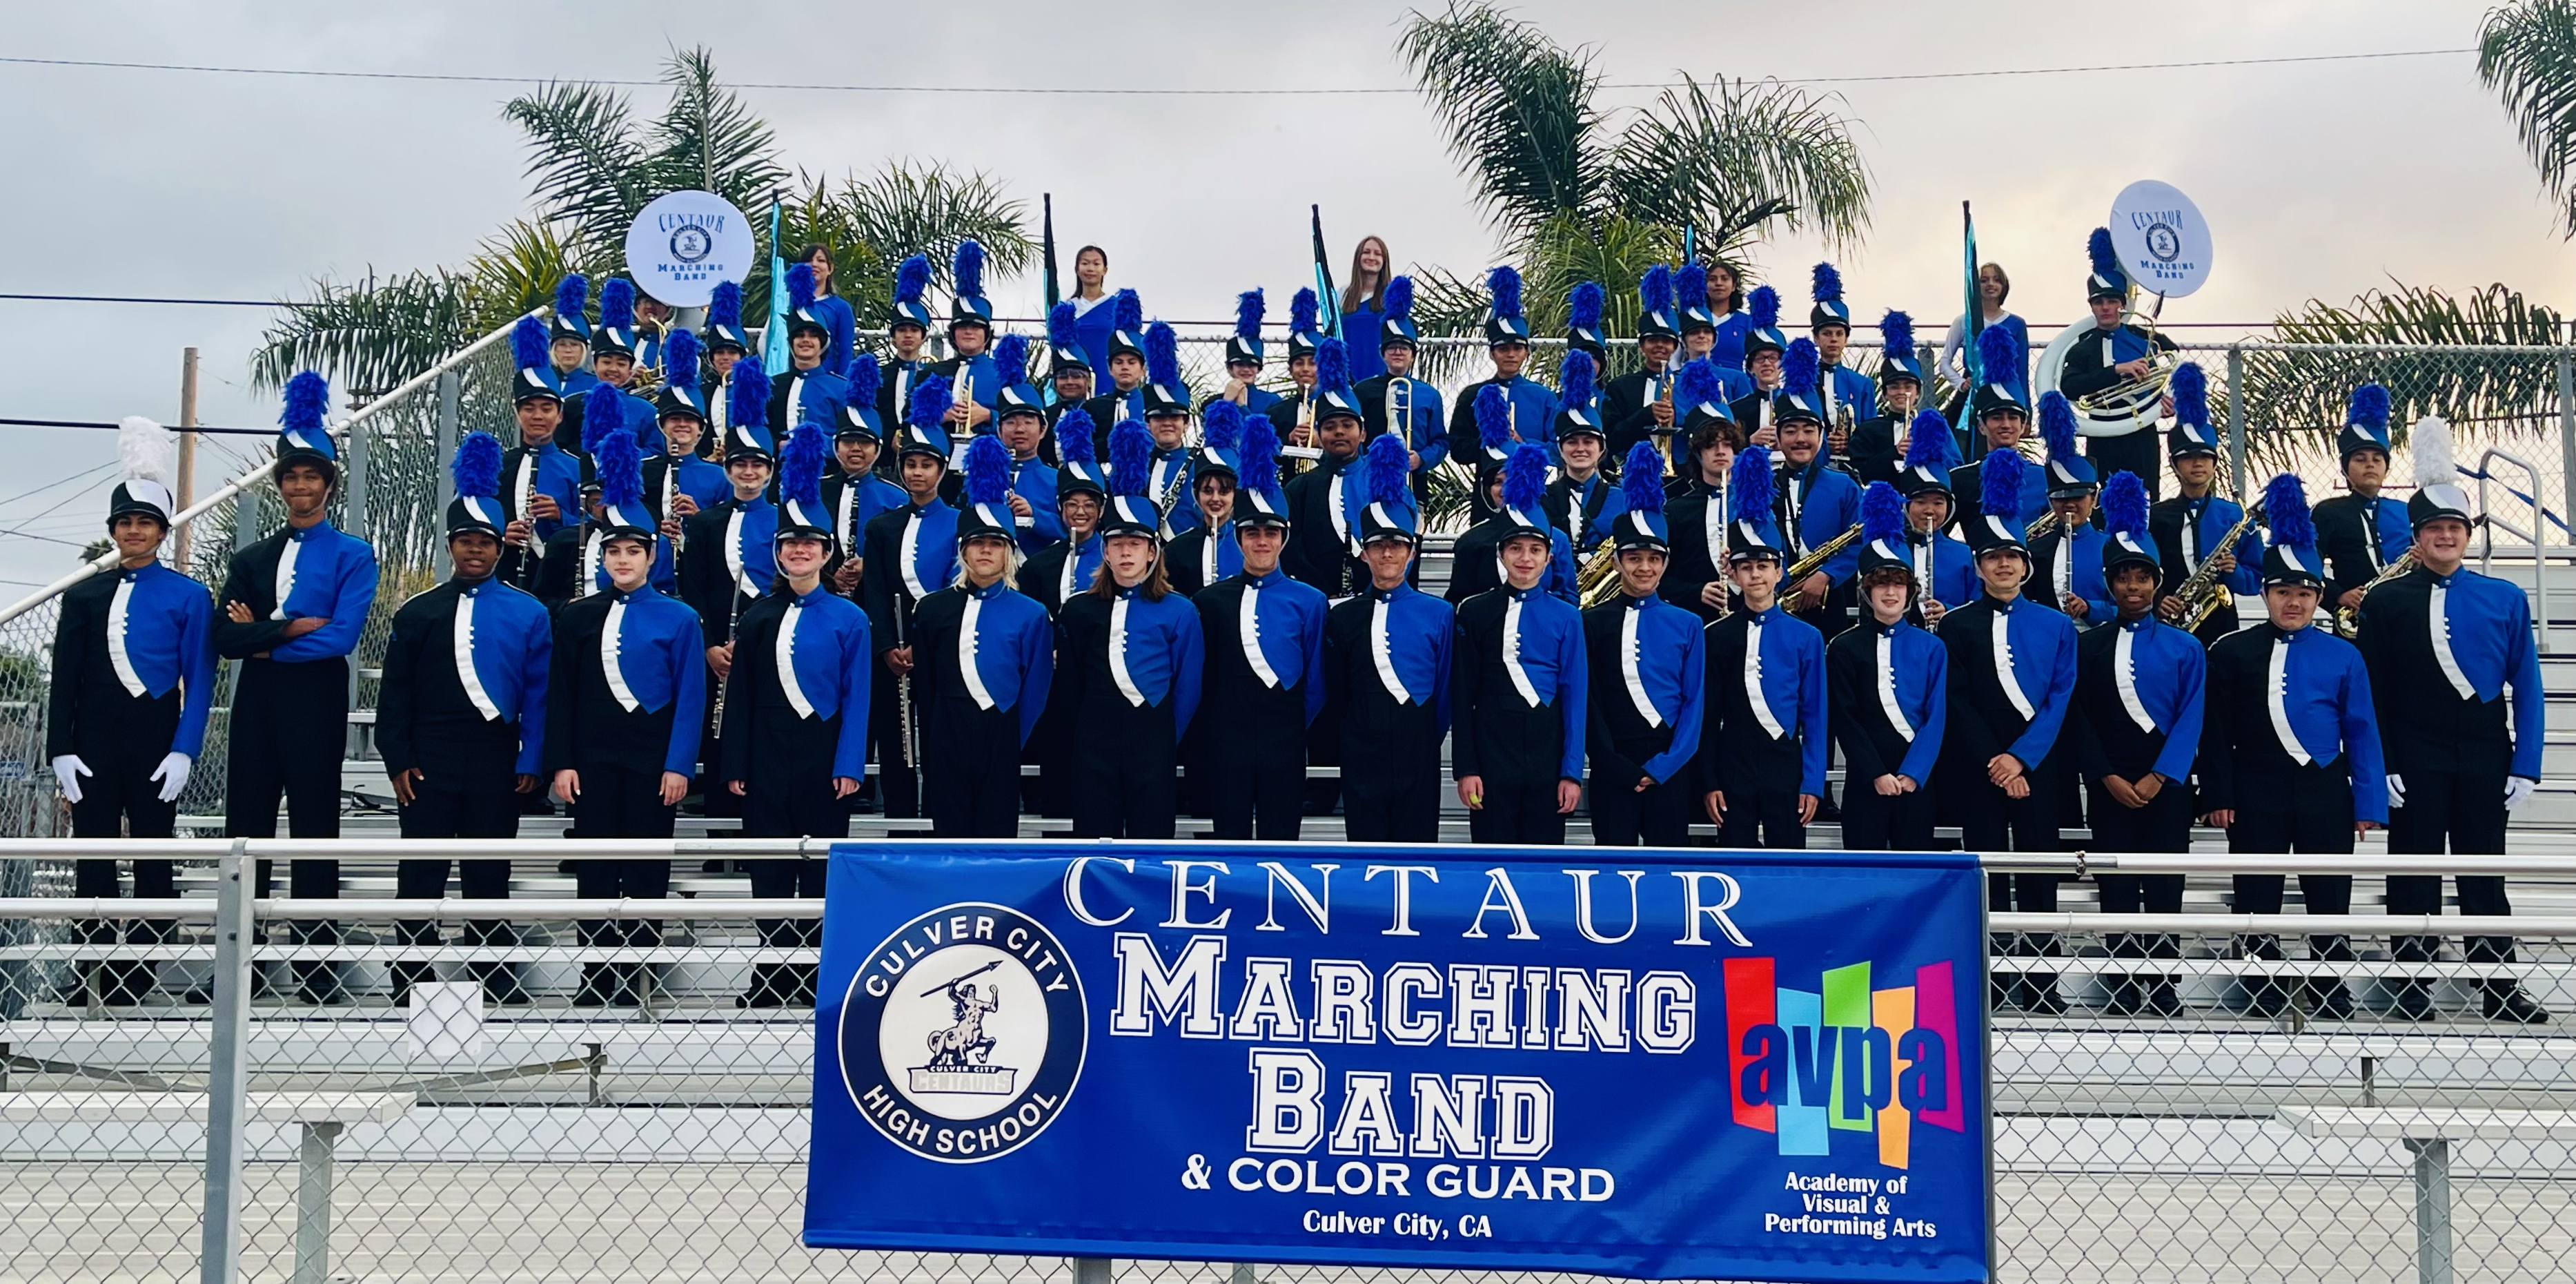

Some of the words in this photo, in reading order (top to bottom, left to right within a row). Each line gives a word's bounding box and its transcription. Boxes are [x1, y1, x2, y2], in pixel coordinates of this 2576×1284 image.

[658, 213, 725, 233] CENTAUR
[2132, 209, 2183, 231] CENTAUR
[658, 264, 724, 272] MARCHING
[2141, 260, 2195, 270] MARCHING
[2156, 270, 2184, 279] BAND
[1063, 857, 1753, 948] CENTAUR
[865, 915, 994, 998] CULVER
[1007, 927, 1069, 993] CITY
[1110, 932, 1696, 1054] MARCHING
[912, 1072, 1012, 1092] CENTAURS
[1740, 1023, 1947, 1120] avpa
[1246, 1047, 1554, 1160] BAND
[863, 1084, 931, 1146] HIGH
[935, 1092, 1057, 1154] SCHOOL
[1181, 1154, 1212, 1190] &
[1228, 1157, 1410, 1196] COLOR
[1426, 1164, 1615, 1202] GUARD
[1784, 1171, 1880, 1197] Academy
[1886, 1175, 1909, 1195] of
[1802, 1193, 1867, 1214] Visual
[1874, 1195, 1891, 1215] &
[1303, 1209, 1386, 1234] Culver
[1393, 1213, 1449, 1242] City,
[1459, 1214, 1493, 1238] CA
[1764, 1213, 1887, 1240] Performing
[1892, 1218, 1937, 1238] Arts
